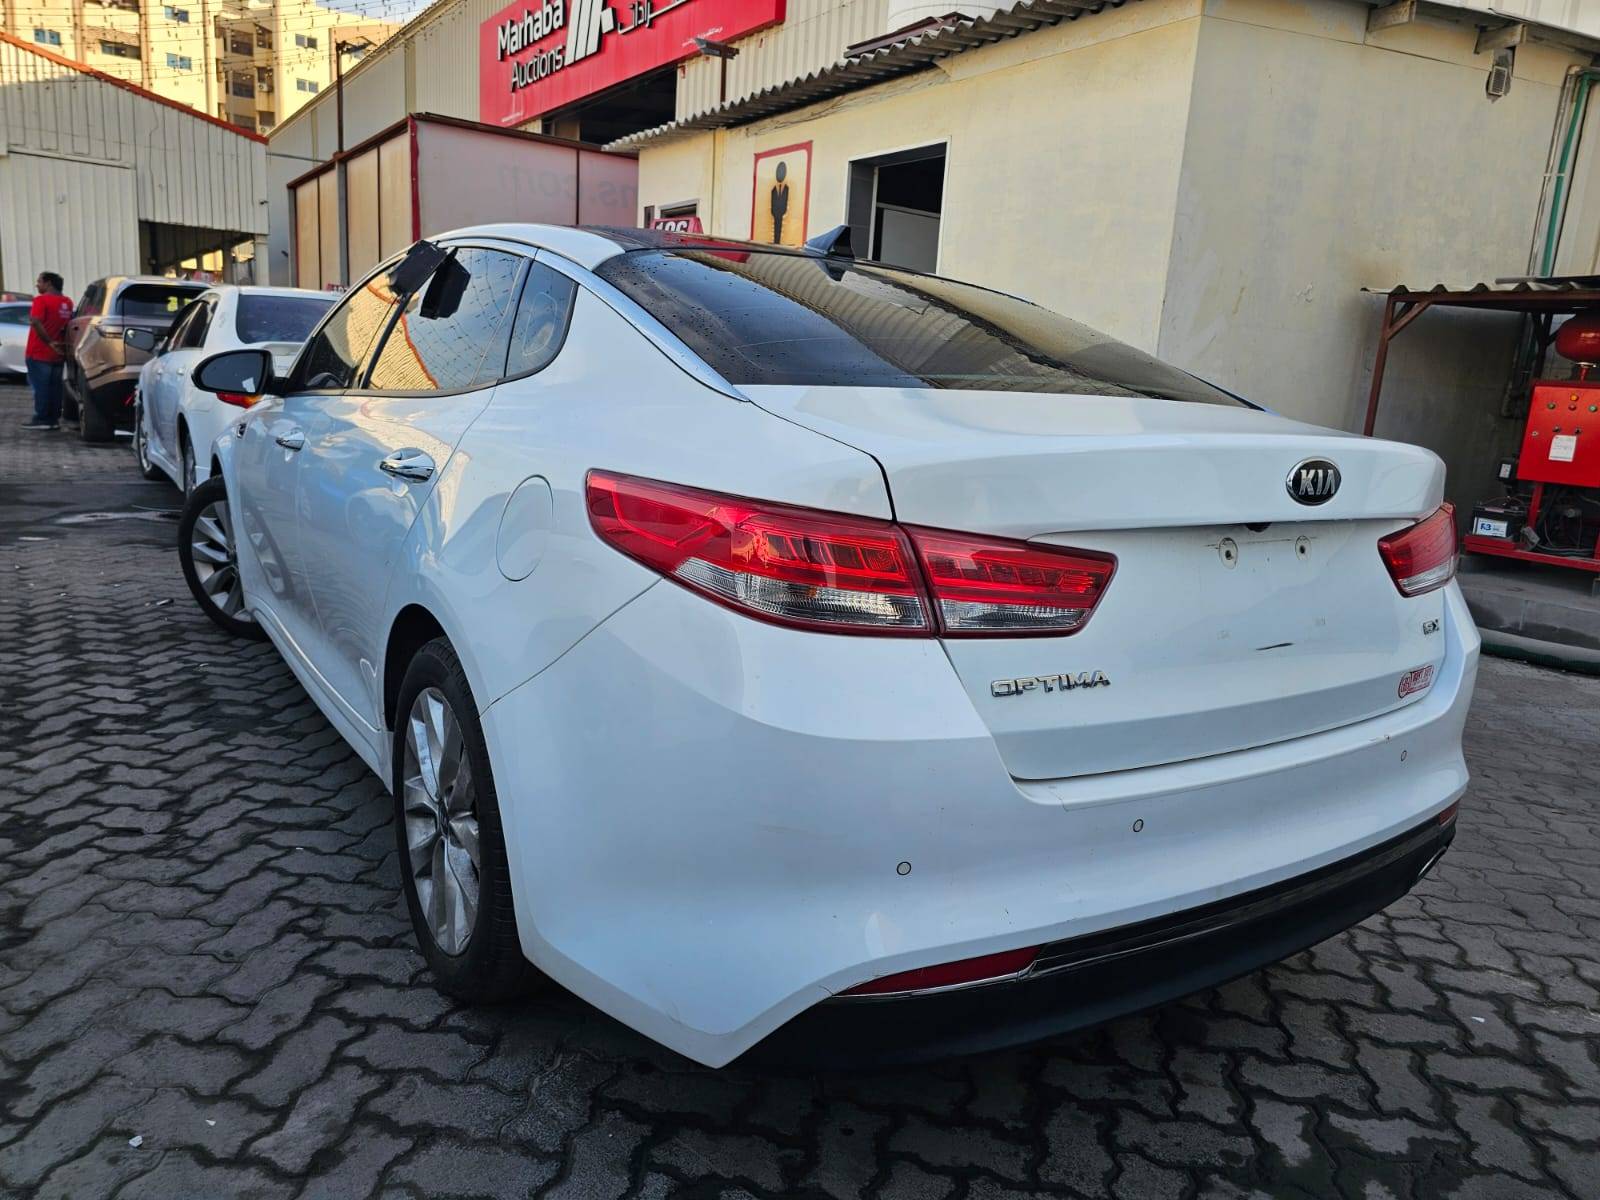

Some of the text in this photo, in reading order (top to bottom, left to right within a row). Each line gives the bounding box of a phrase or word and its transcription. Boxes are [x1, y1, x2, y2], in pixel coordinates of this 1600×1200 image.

[497, 0, 563, 61] Marhaba
[511, 45, 563, 89] Auctions
[1299, 469, 1336, 495] KIA
[991, 670, 1111, 697] OPTIMA
